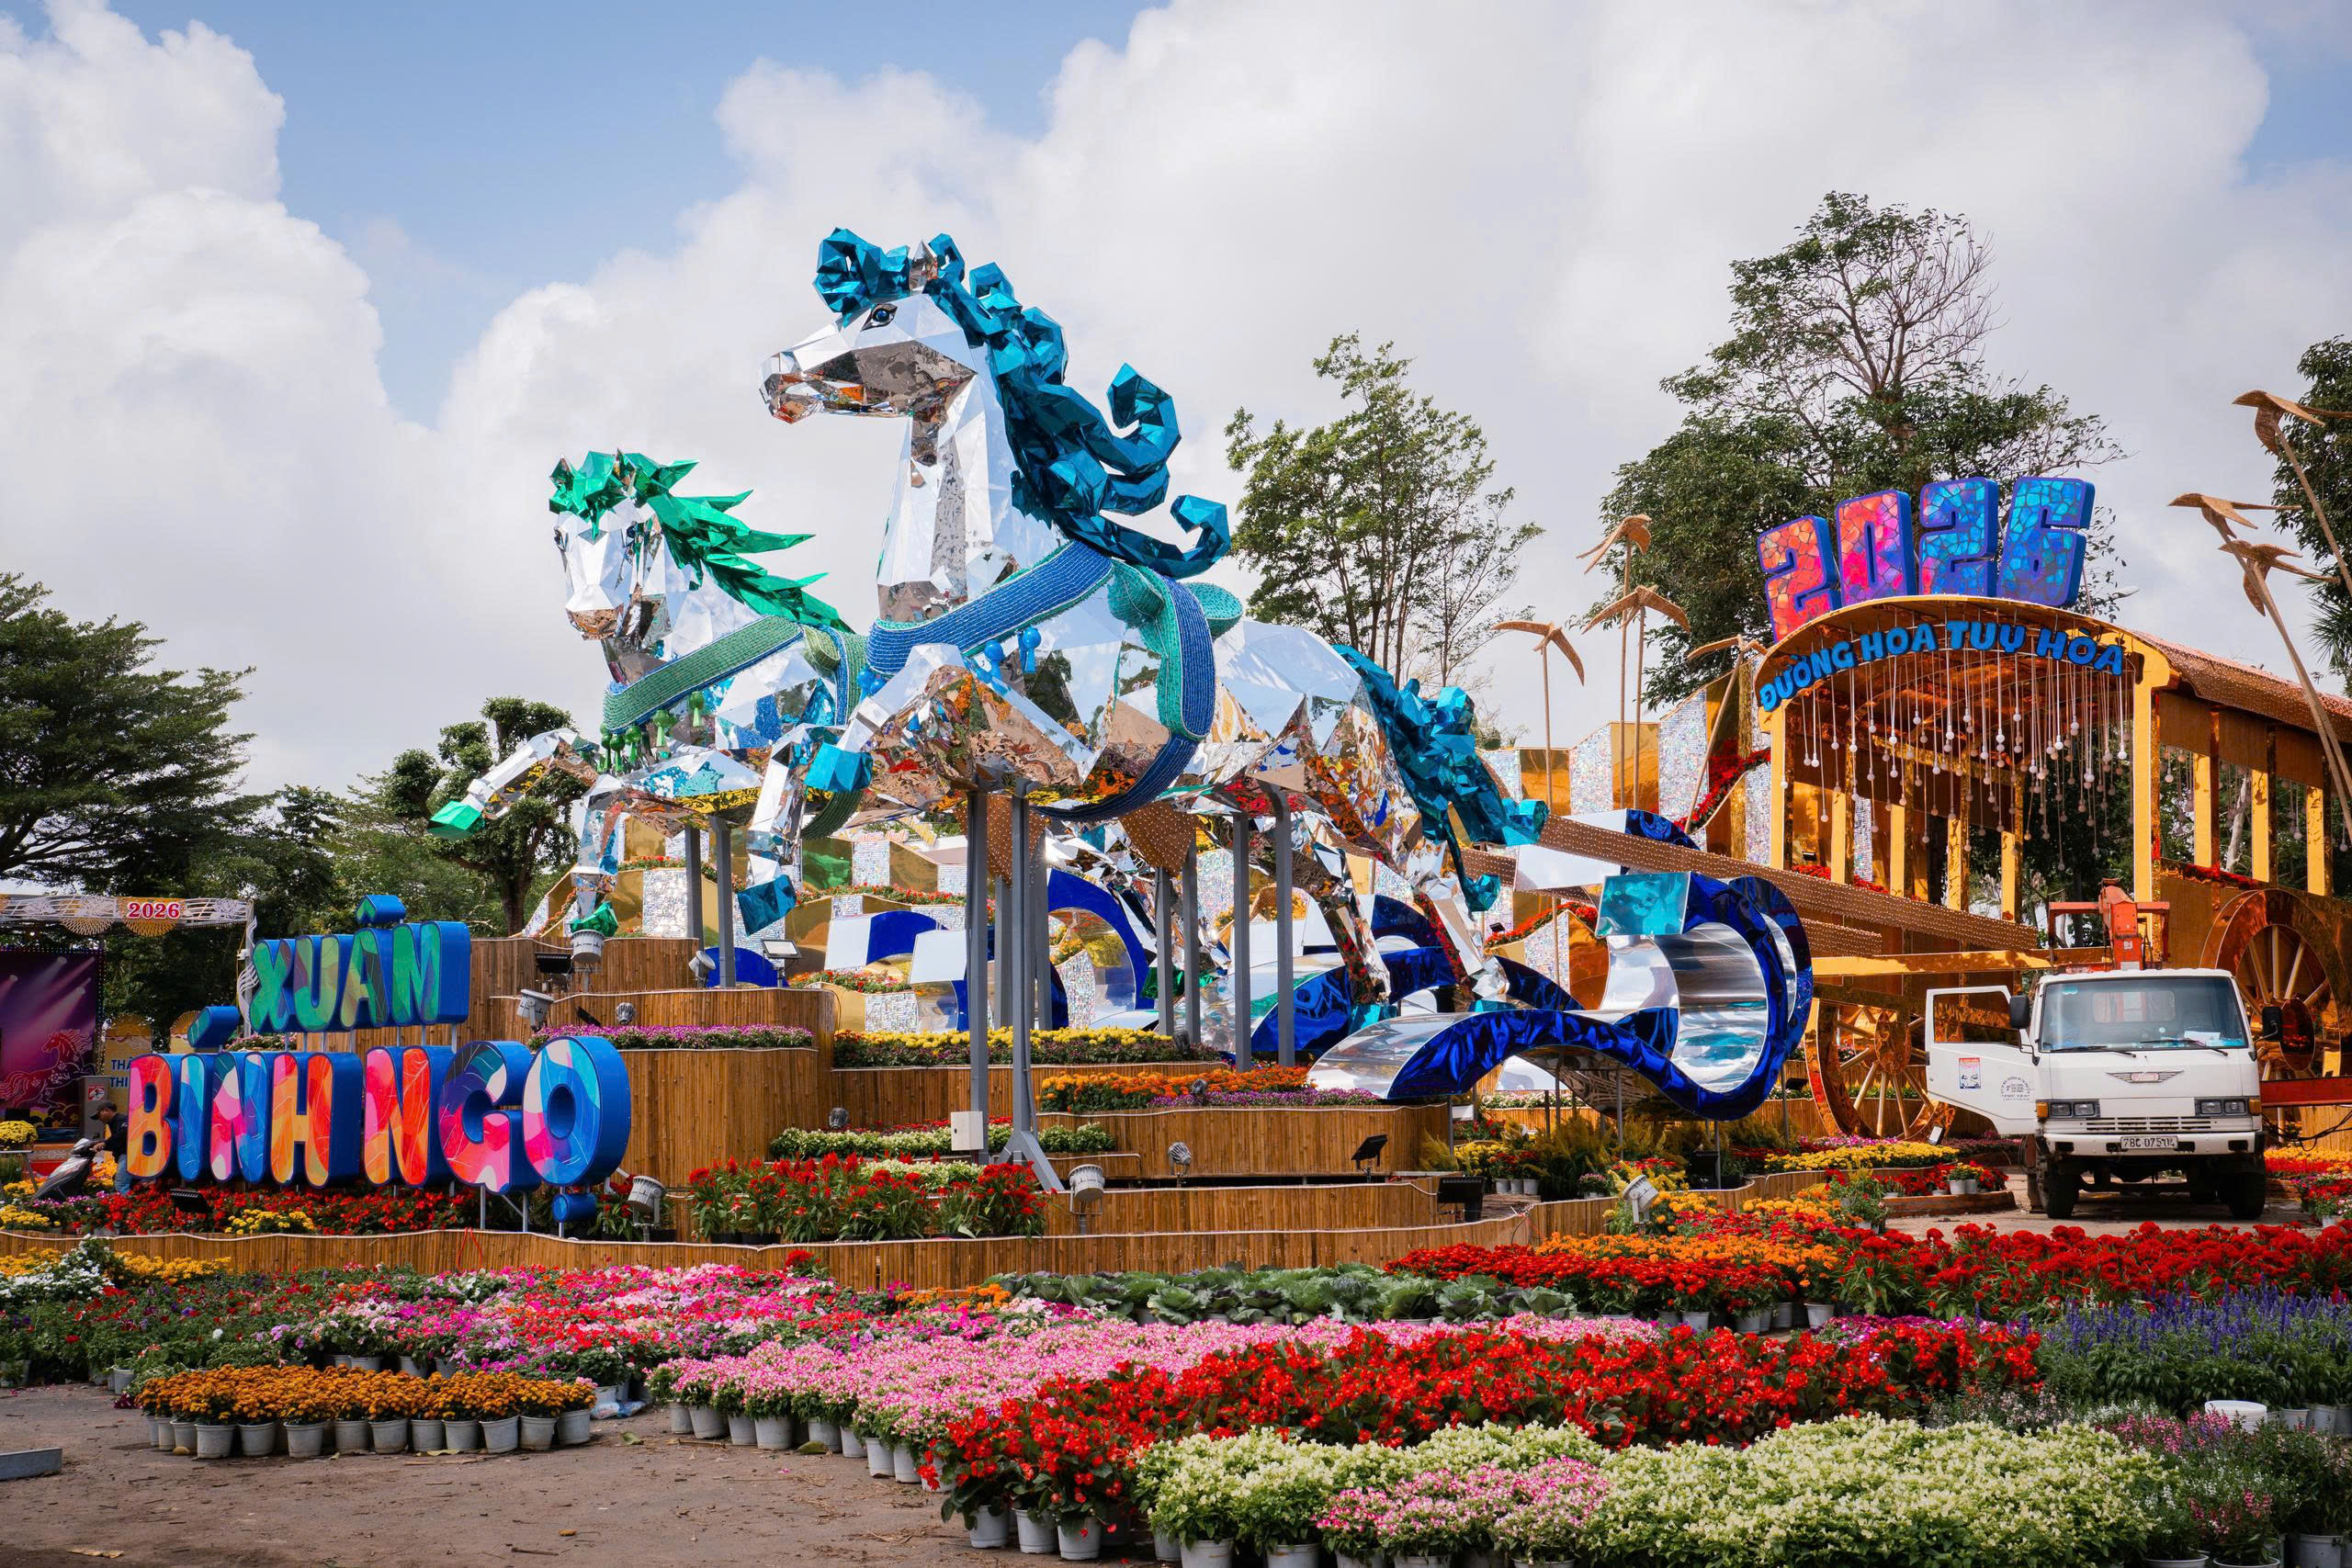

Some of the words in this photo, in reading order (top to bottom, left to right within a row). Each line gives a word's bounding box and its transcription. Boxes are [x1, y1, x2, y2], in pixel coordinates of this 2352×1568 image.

[1757, 476, 2096, 643] 2026
[1759, 639, 1857, 713] ĐƯỜNG
[1859, 622, 1940, 663] HOA
[1945, 620, 2027, 654] TUY
[2035, 626, 2125, 677] HÒA
[127, 901, 182, 919] 2026
[249, 894, 470, 1034] XUÂN
[126, 1005, 364, 1190] BÍNH
[364, 1035, 632, 1224] NGỌ
